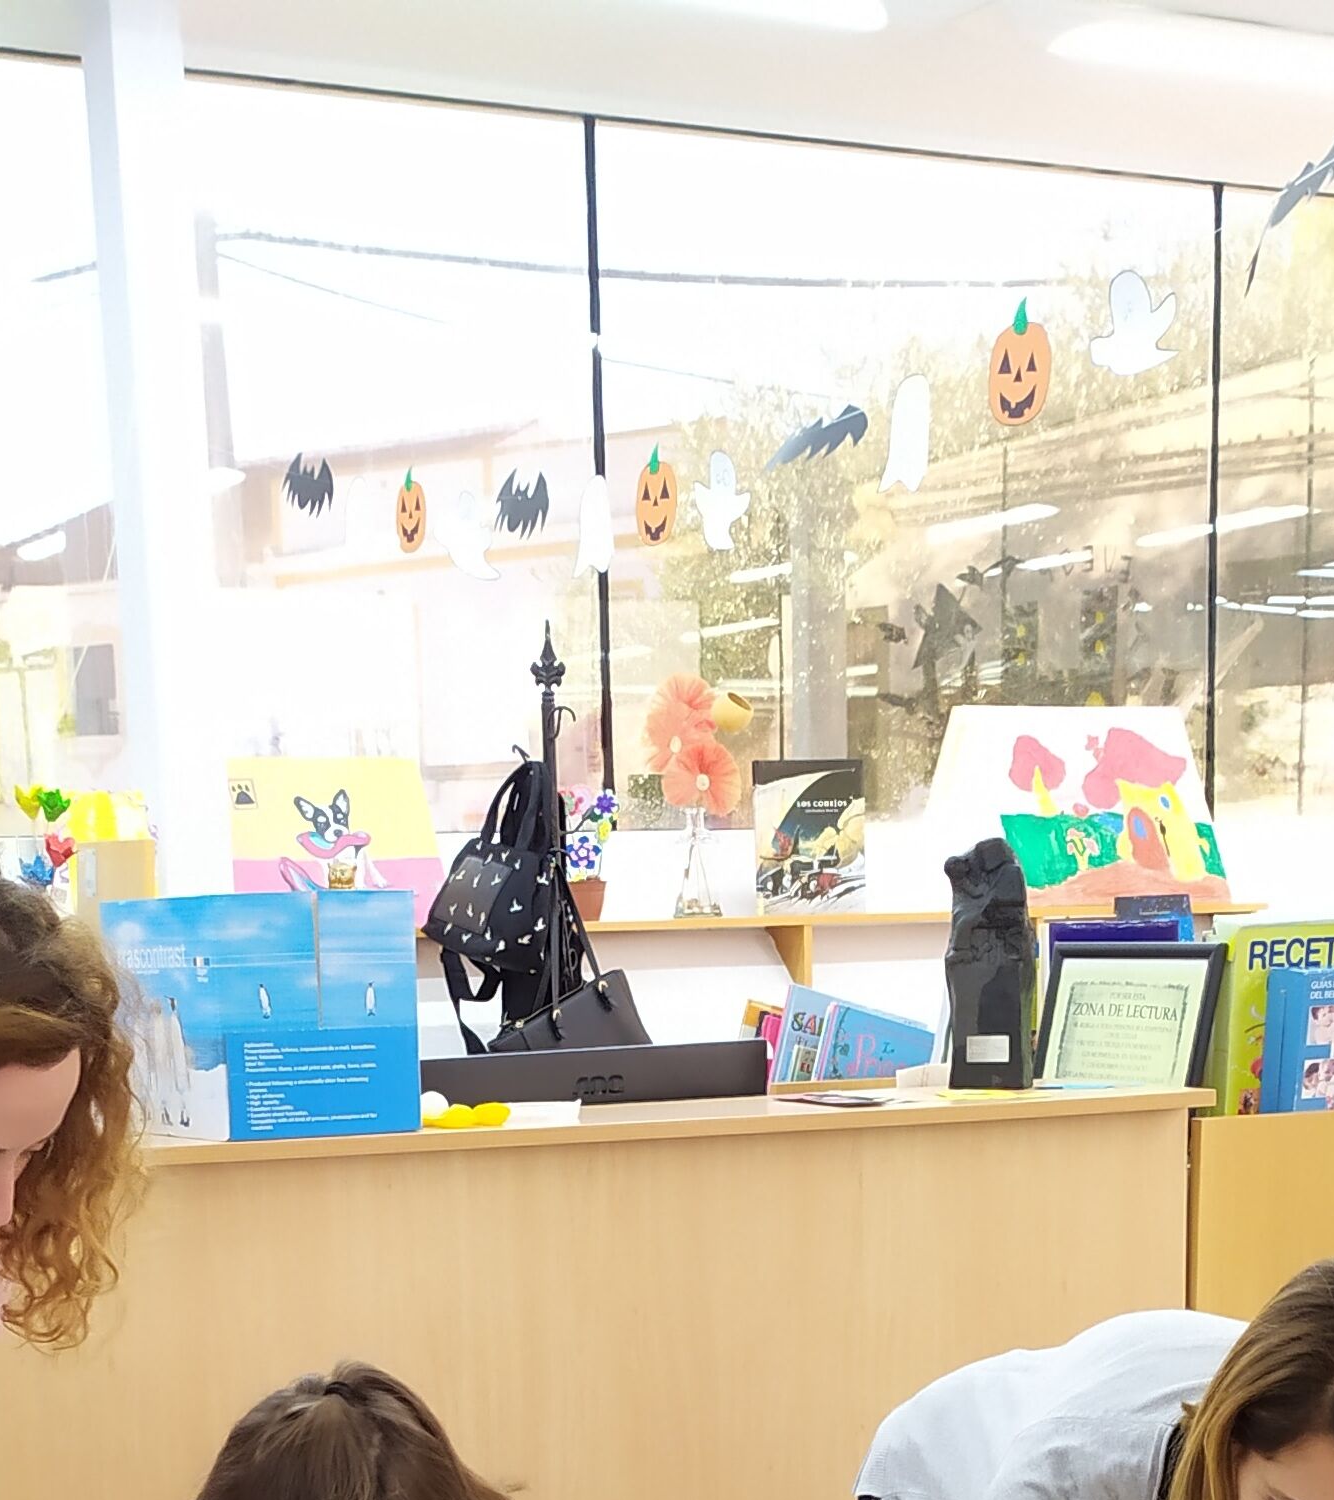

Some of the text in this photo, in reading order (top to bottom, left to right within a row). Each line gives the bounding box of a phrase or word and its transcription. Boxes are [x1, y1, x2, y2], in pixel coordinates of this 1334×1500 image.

[1072, 1002, 1178, 1022] ZONA DE LECTURA
